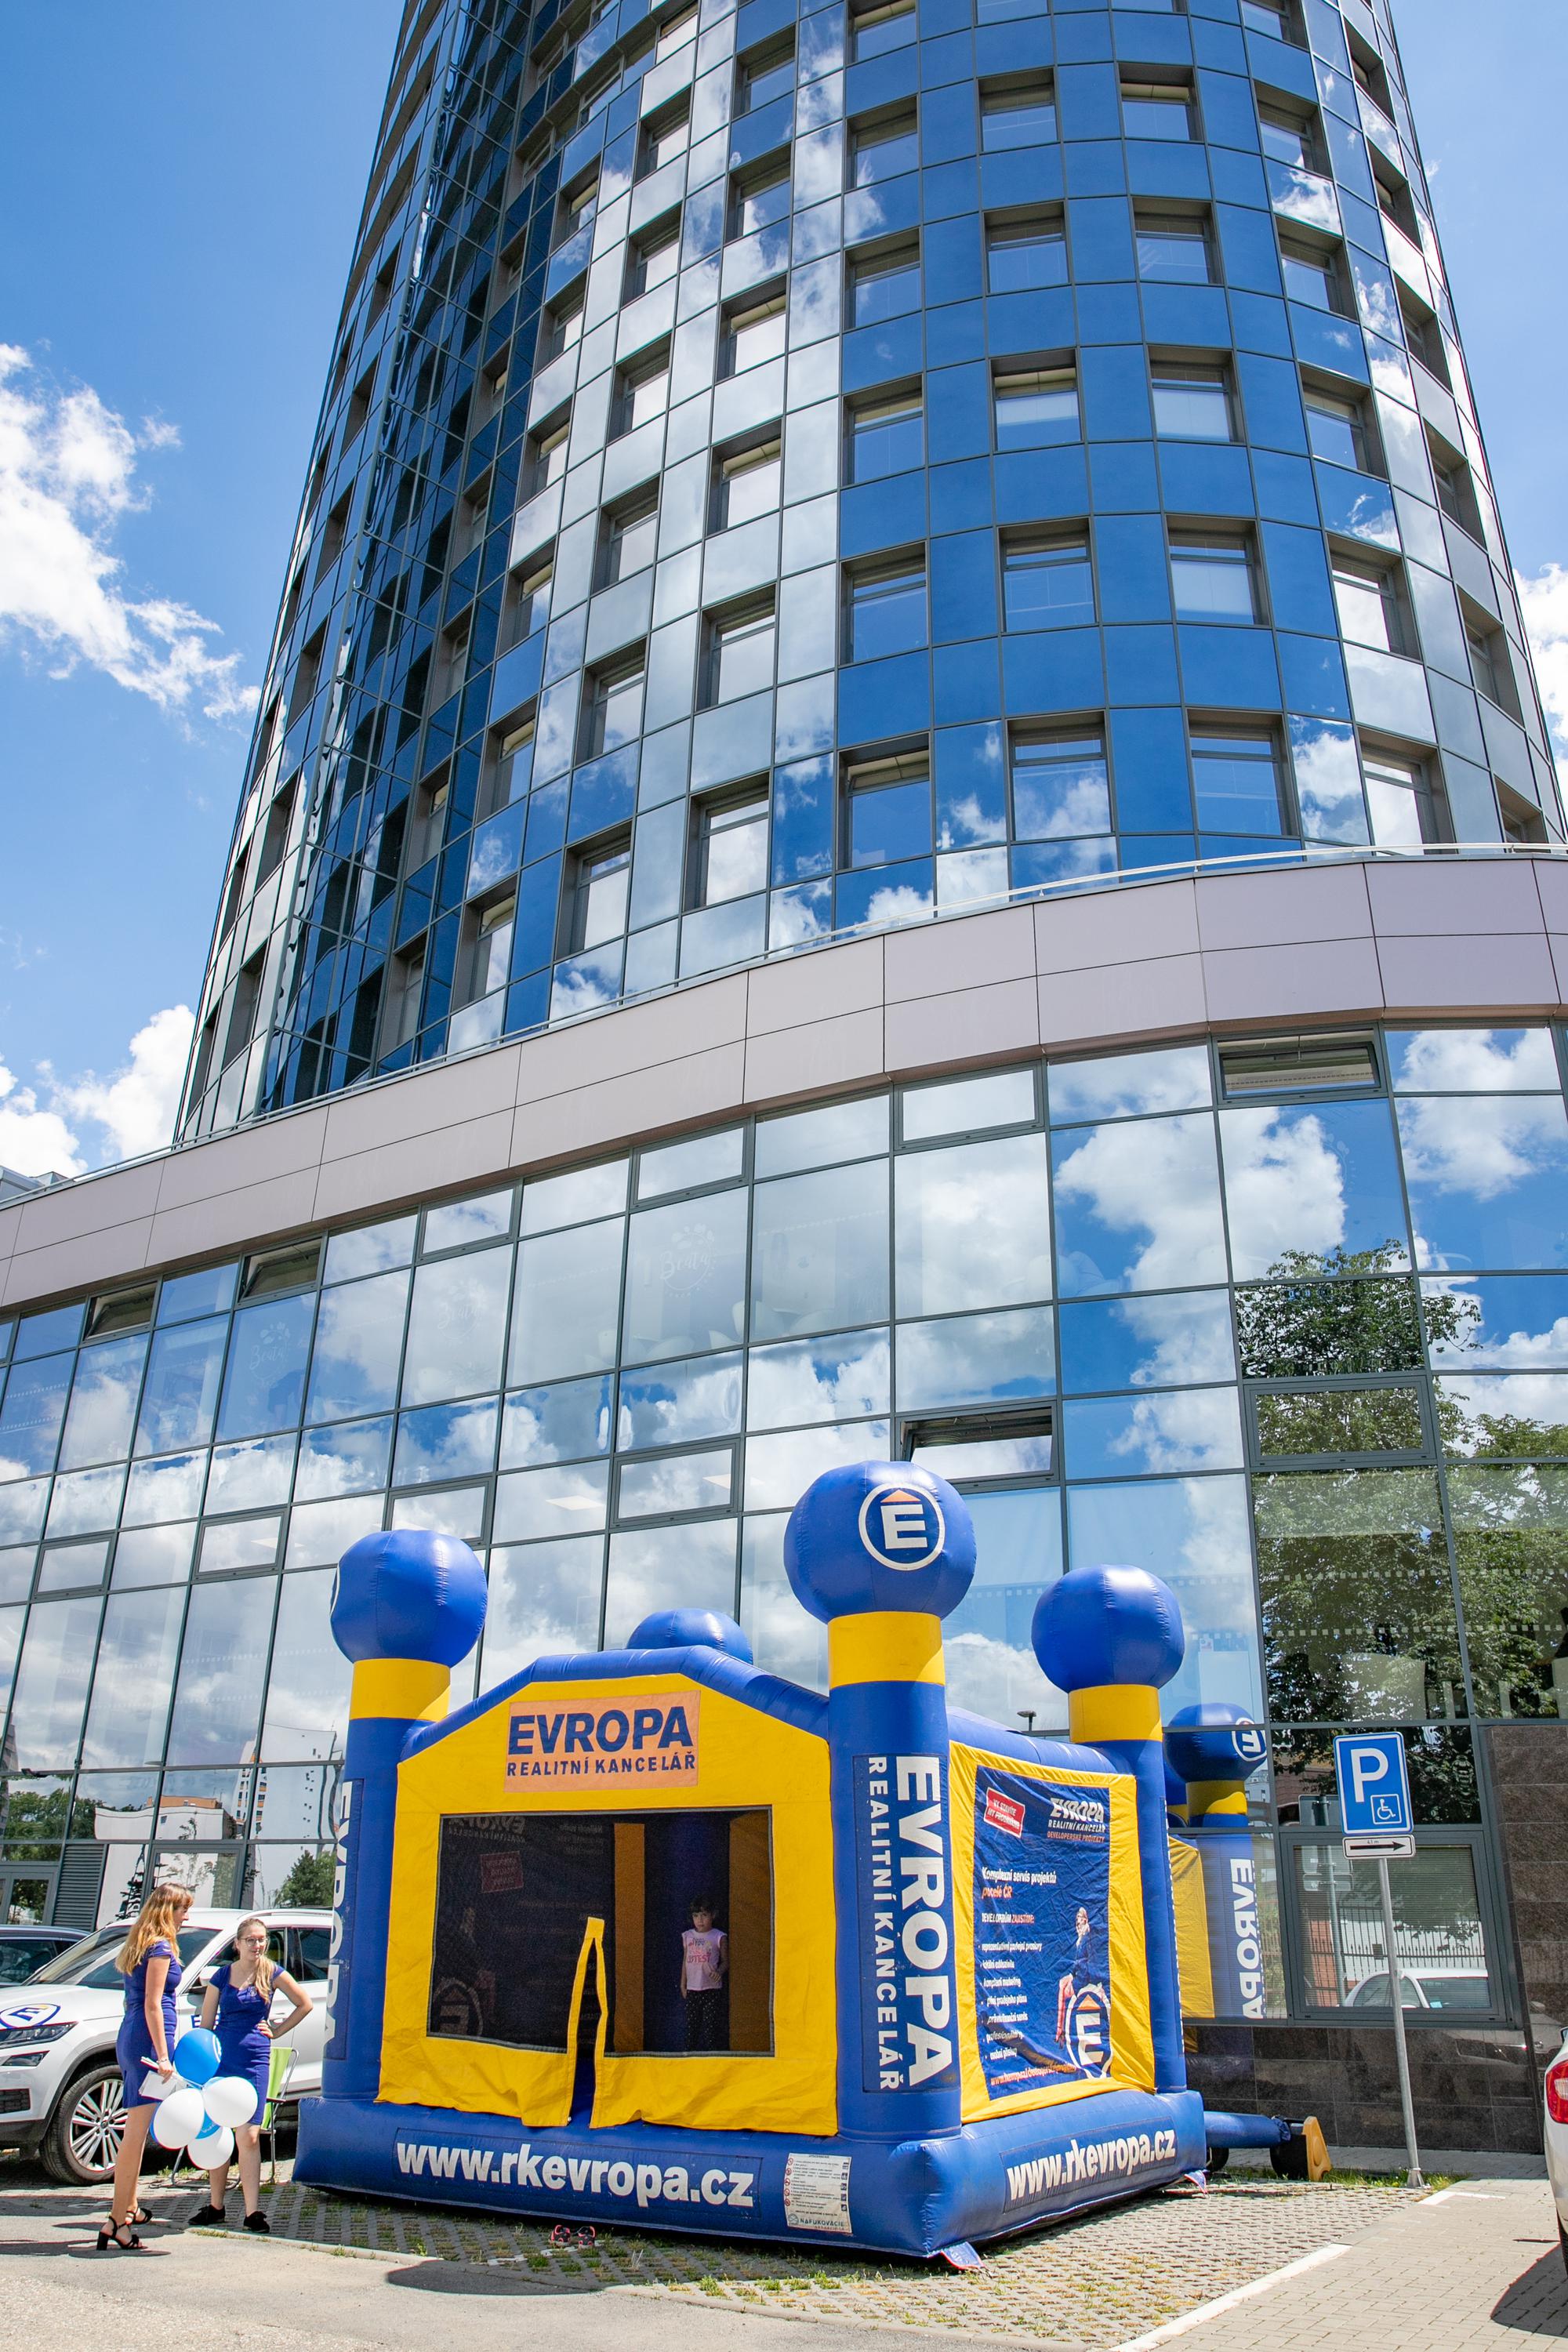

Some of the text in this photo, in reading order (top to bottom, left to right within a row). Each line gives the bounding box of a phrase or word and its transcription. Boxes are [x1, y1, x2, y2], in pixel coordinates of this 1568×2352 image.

[507, 1706, 693, 1755] EVROPA
[506, 1751, 696, 1777] REALITNÍ KANCELÁŘ
[1350, 1748, 1389, 1803] P
[1047, 1820, 1076, 1831] REALITNÍ
[1050, 1797, 1104, 1824] EVROPA
[982, 1867, 1013, 1882] Komplexní
[1013, 1871, 1030, 1882] servis
[868, 1756, 904, 2089] REALITNÍ KANCELÁŘ
[896, 1756, 953, 2086] EVROPA
[396, 2142, 754, 2208] www.rkevropa.cz
[1006, 2129, 1176, 2201] www.rkevropa.cz
